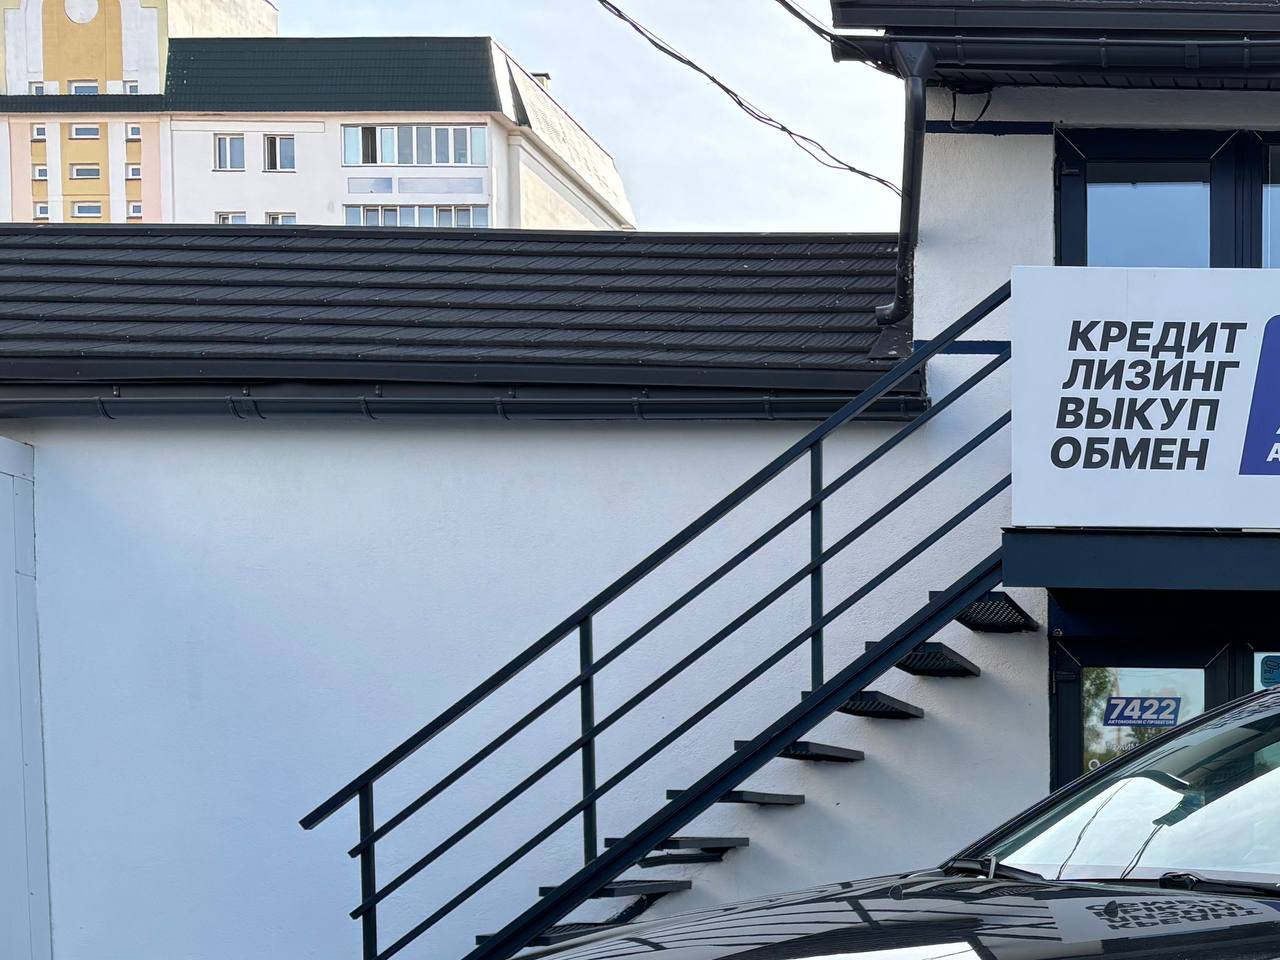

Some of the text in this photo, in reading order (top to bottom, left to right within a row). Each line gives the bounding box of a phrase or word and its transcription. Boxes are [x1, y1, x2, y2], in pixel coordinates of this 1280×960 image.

[1067, 320, 1248, 362] КРЕДИТ
[1062, 359, 1240, 392] ЛИЗИНГ
[1055, 397, 1221, 432] ВЫКУП
[1050, 436, 1209, 472] ОБМЕН
[1109, 698, 1177, 720] 7422
